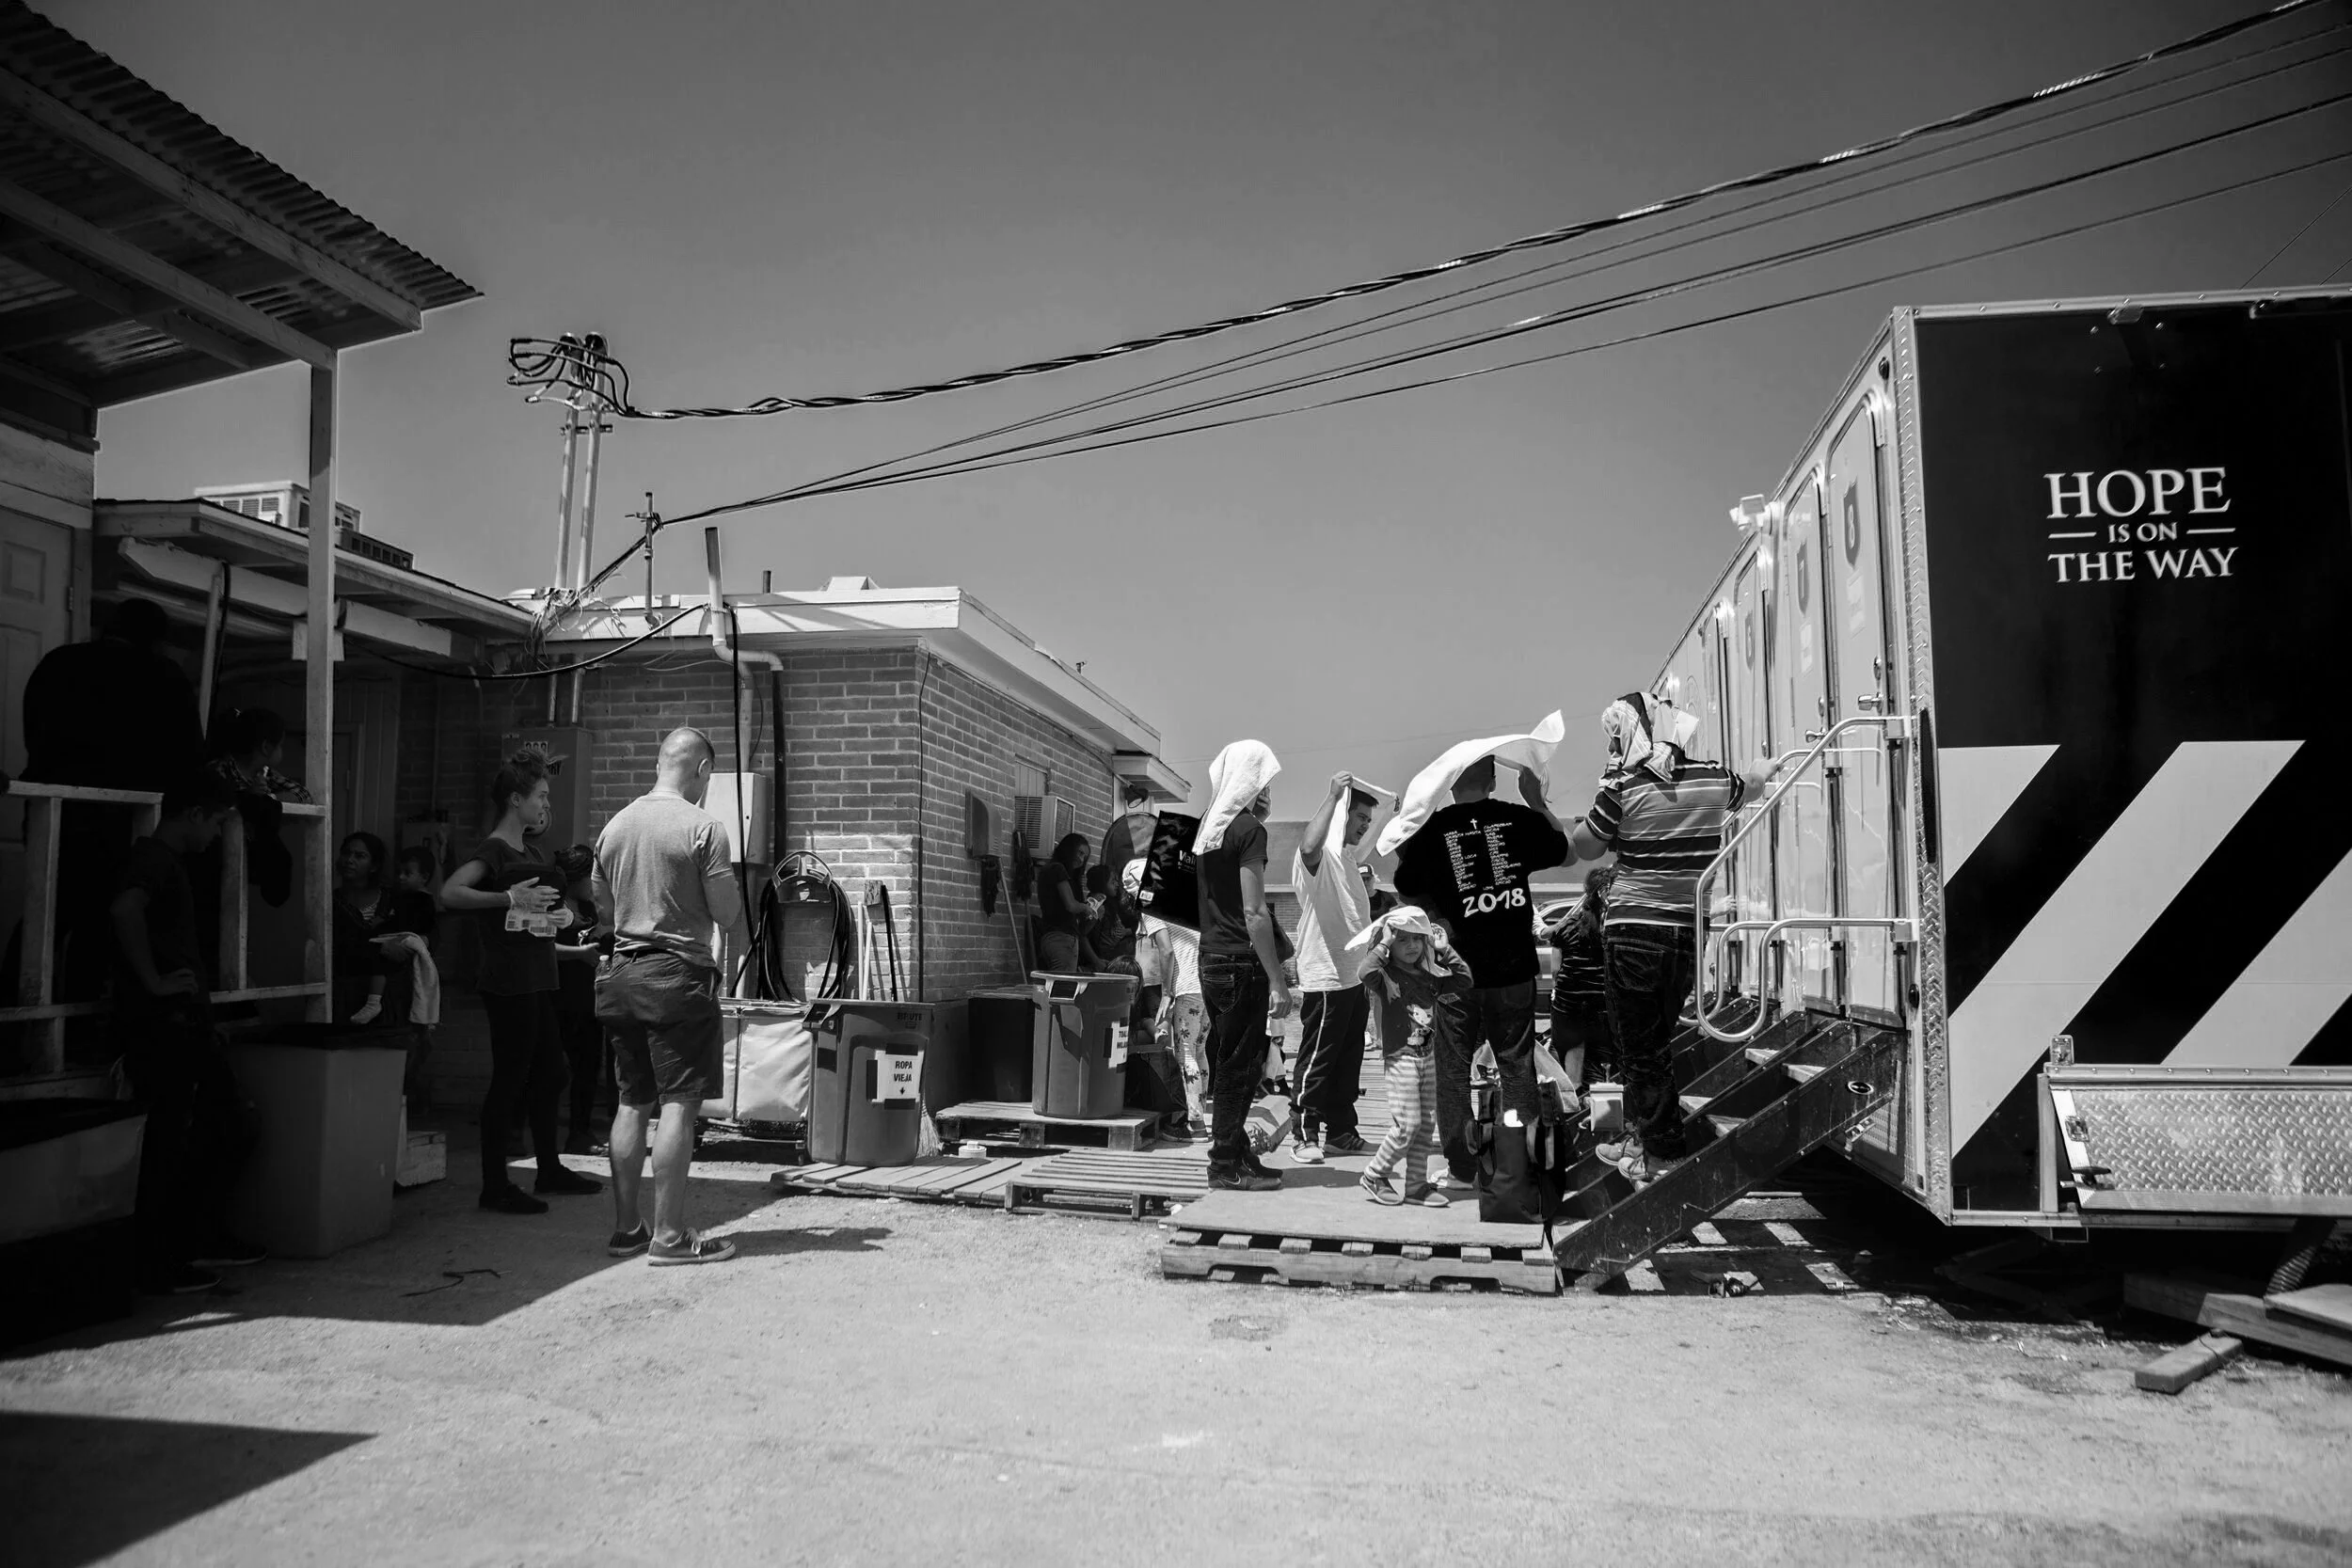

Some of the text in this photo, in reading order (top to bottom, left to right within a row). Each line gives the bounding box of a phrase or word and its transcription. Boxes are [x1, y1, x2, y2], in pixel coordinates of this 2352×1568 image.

[2042, 467, 2232, 519] HOPE
[1848, 503, 1855, 550] 8
[2108, 521, 2178, 544] IS ON
[2047, 546, 2239, 583] THE WAY
[1462, 888, 1526, 918] 2018
[893, 1073, 913, 1082] VIEJA
[895, 1060, 913, 1069] ROPA
